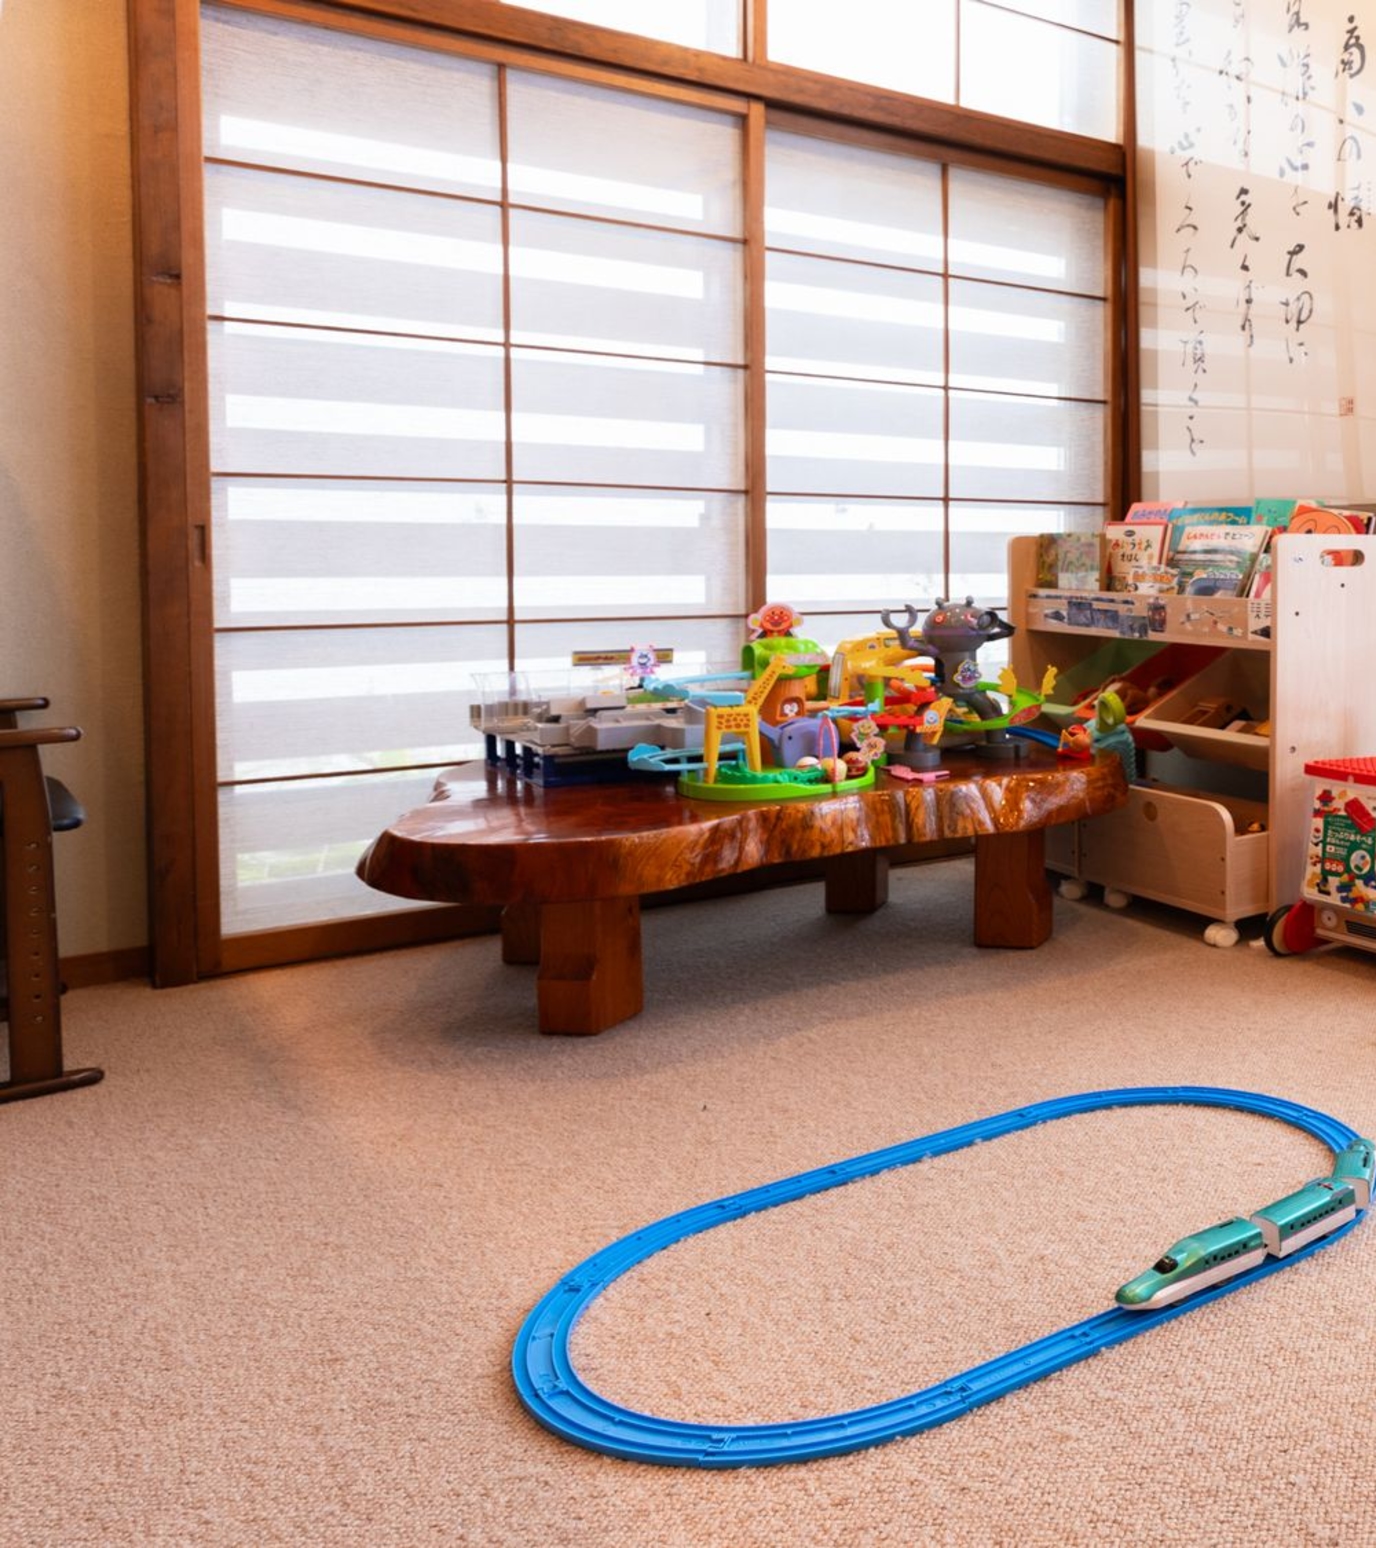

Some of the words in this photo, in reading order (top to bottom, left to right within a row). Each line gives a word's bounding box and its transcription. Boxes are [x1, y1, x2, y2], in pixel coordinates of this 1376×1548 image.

[1111, 538, 1153, 552] あいうえお
